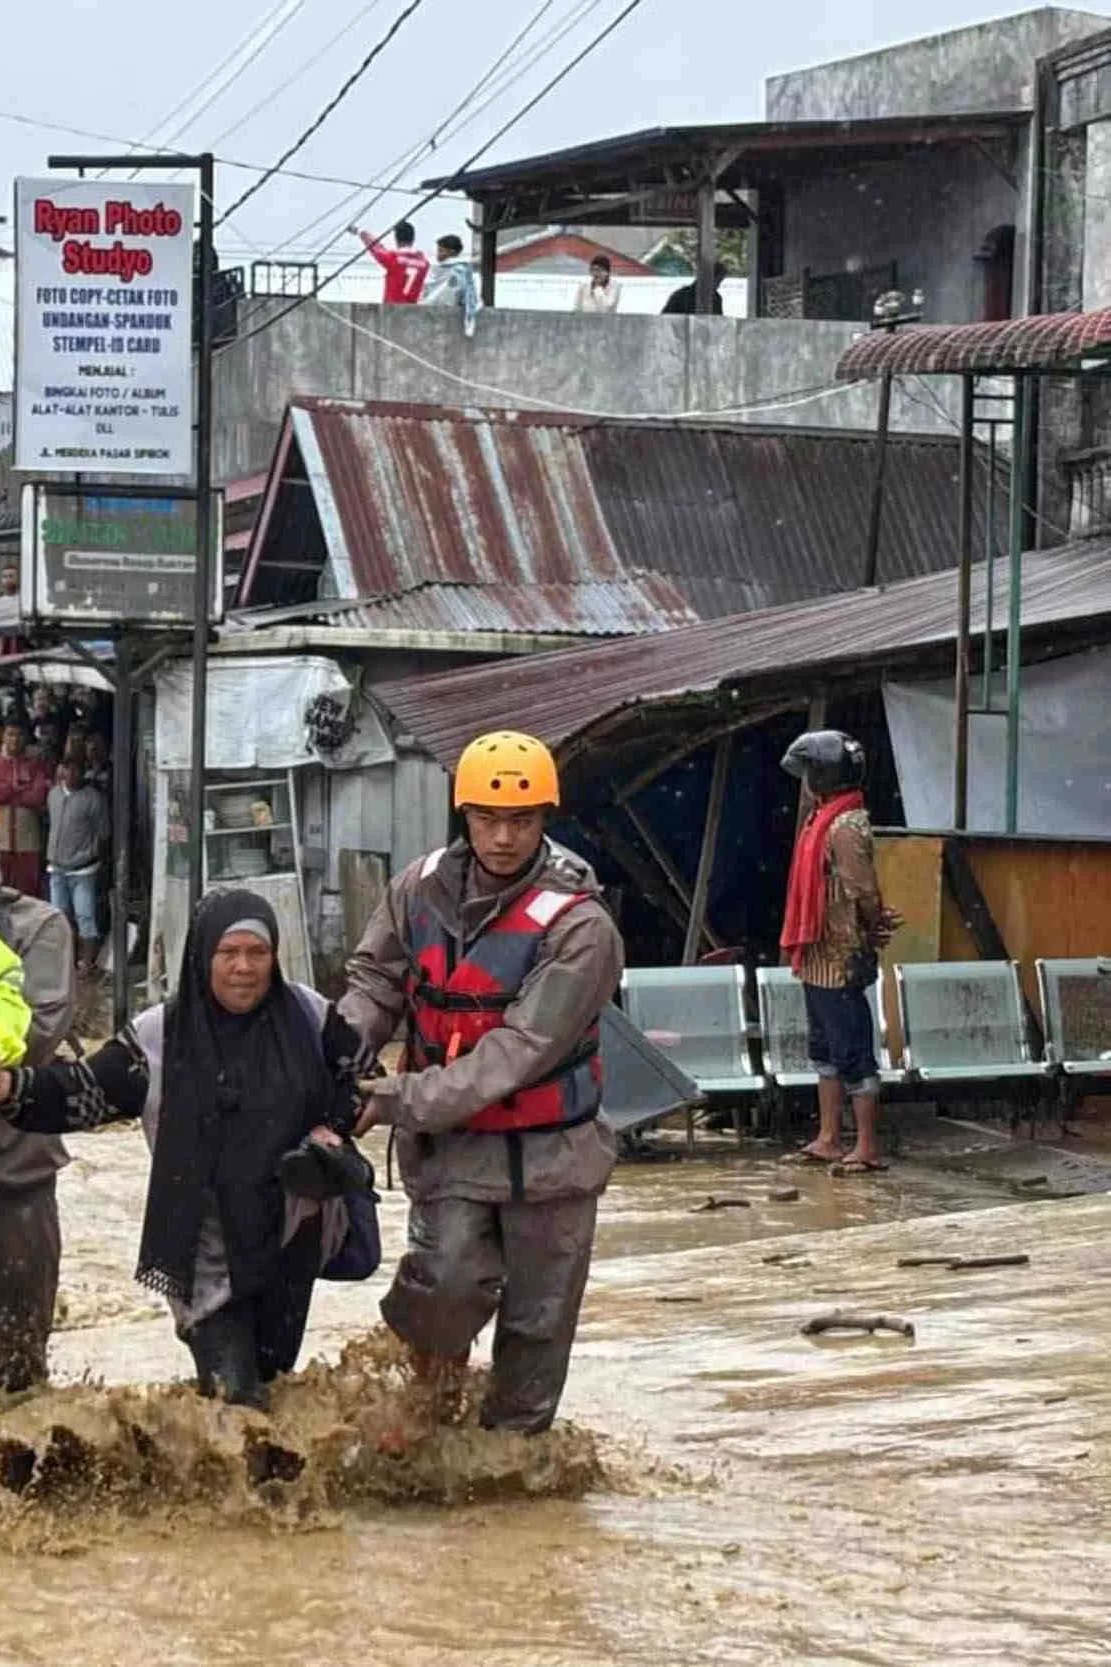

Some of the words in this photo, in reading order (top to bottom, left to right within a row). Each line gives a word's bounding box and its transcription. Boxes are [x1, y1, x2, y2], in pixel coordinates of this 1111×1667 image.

[34, 199, 100, 242] Ryan
[104, 200, 182, 237] Photo
[62, 239, 153, 283] Studyo
[402, 267, 418, 296] 7
[36, 287, 67, 304] FOTO
[70, 288, 145, 306] COPY-CETAK
[147, 289, 178, 307] FOTO
[53, 335, 124, 353] STEMPEL-ID
[127, 337, 161, 353] CARD
[90, 387, 120, 399] FOTO
[131, 388, 166, 399] ALBUM
[31, 404, 91, 416] ALAT-ALAT
[94, 404, 139, 417] KANTOR
